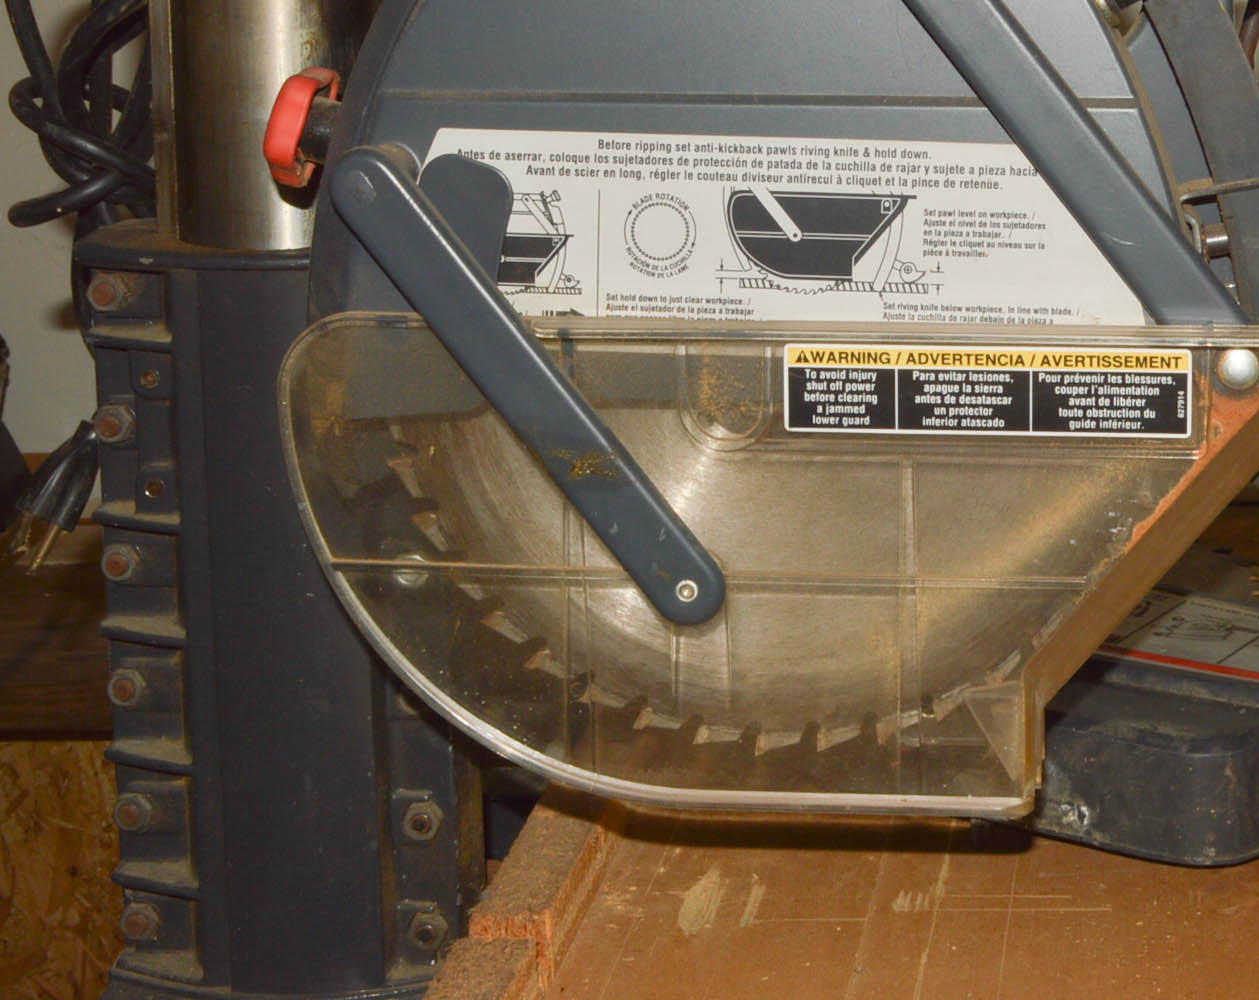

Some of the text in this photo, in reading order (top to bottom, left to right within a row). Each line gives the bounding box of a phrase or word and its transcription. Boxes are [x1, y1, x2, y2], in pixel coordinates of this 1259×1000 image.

[597, 138, 930, 159] Before ripping set anti-kickback pawls riving knife & hold down.
[488, 149, 501, 160] de
[549, 151, 590, 165] coloque
[593, 152, 609, 164] los
[612, 154, 673, 167] sujetadores
[676, 155, 689, 166] de
[692, 156, 747, 168] protección
[750, 157, 763, 168] de
[767, 158, 802, 171] patada
[805, 159, 818, 170] de
[822, 159, 831, 170] la
[834, 160, 876, 172] cuchilla
[879, 162, 892, 172] de
[896, 162, 920, 175] rajar
[923, 165, 930, 176] y
[933, 163, 965, 176] sujete
[968, 166, 974, 174] a
[978, 165, 1005, 177] pieza
[1009, 166, 1038, 177] hacia
[525, 164, 555, 176] Avant
[558, 165, 571, 176] de
[574, 166, 600, 177] scier
[602, 169, 615, 178] en
[649, 168, 680, 182] régler
[683, 169, 693, 180] le
[696, 170, 738, 182] couteau
[741, 171, 783, 183] diviseur
[836, 174, 842, 184] à
[845, 174, 881, 188] cliquet
[884, 176, 895, 186] et
[898, 175, 908, 187] la
[911, 176, 939, 189] pince
[943, 177, 956, 188] de
[810, 350, 890, 364] WARNING
[905, 352, 1025, 366] ADVERTENCIA
[1039, 354, 1182, 368] AVERTISSEMENT
[804, 369, 877, 382] To avoid injury
[912, 370, 1014, 384] Para evitar lesiones,
[1038, 372, 1176, 386] Pour prévenir les blessures,
[805, 381, 875, 395] shut off power
[923, 383, 1004, 395] apague la sierra
[1055, 385, 1160, 397] couper l'alimentation
[804, 392, 877, 406] before clearing
[914, 393, 1013, 405] antes de desatascar
[1068, 396, 1147, 407] avant de libérer
[816, 404, 865, 415] a jammed
[933, 406, 993, 418] un protector
[1058, 408, 1155, 419] toute obstruction du
[812, 413, 869, 426] lower guard
[922, 416, 1004, 427] inferior atascado
[1068, 419, 1144, 430] guide inférieur.
